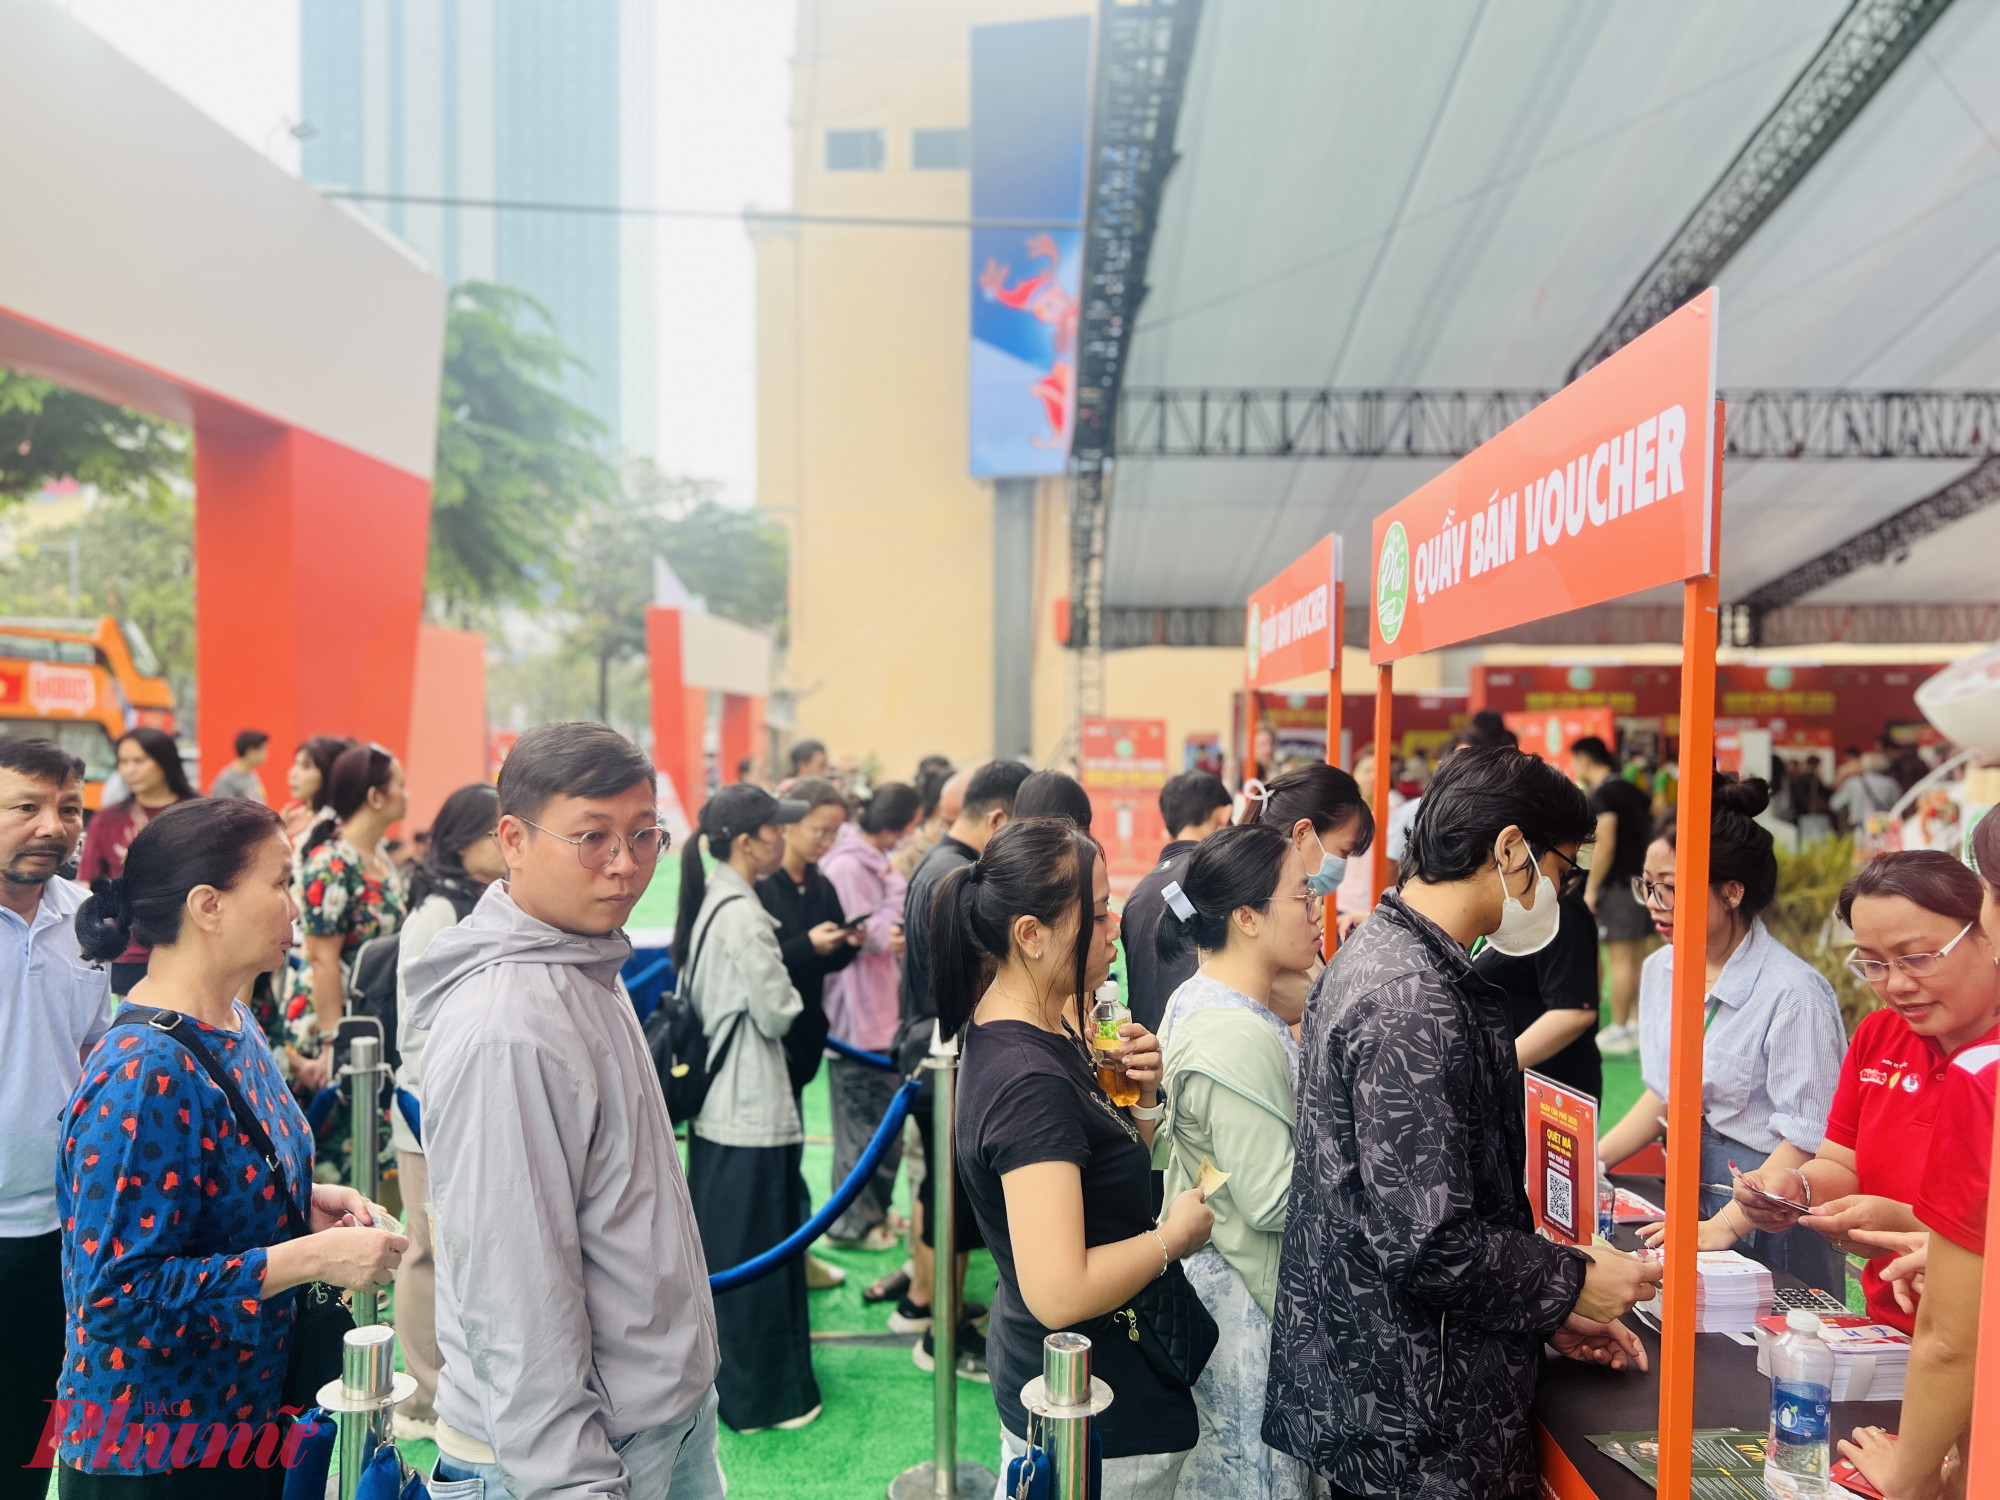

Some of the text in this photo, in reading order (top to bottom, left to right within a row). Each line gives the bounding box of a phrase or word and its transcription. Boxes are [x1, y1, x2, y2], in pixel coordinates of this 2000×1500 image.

[1414, 404, 1687, 604] QUẦY BÁN VOUCHER
